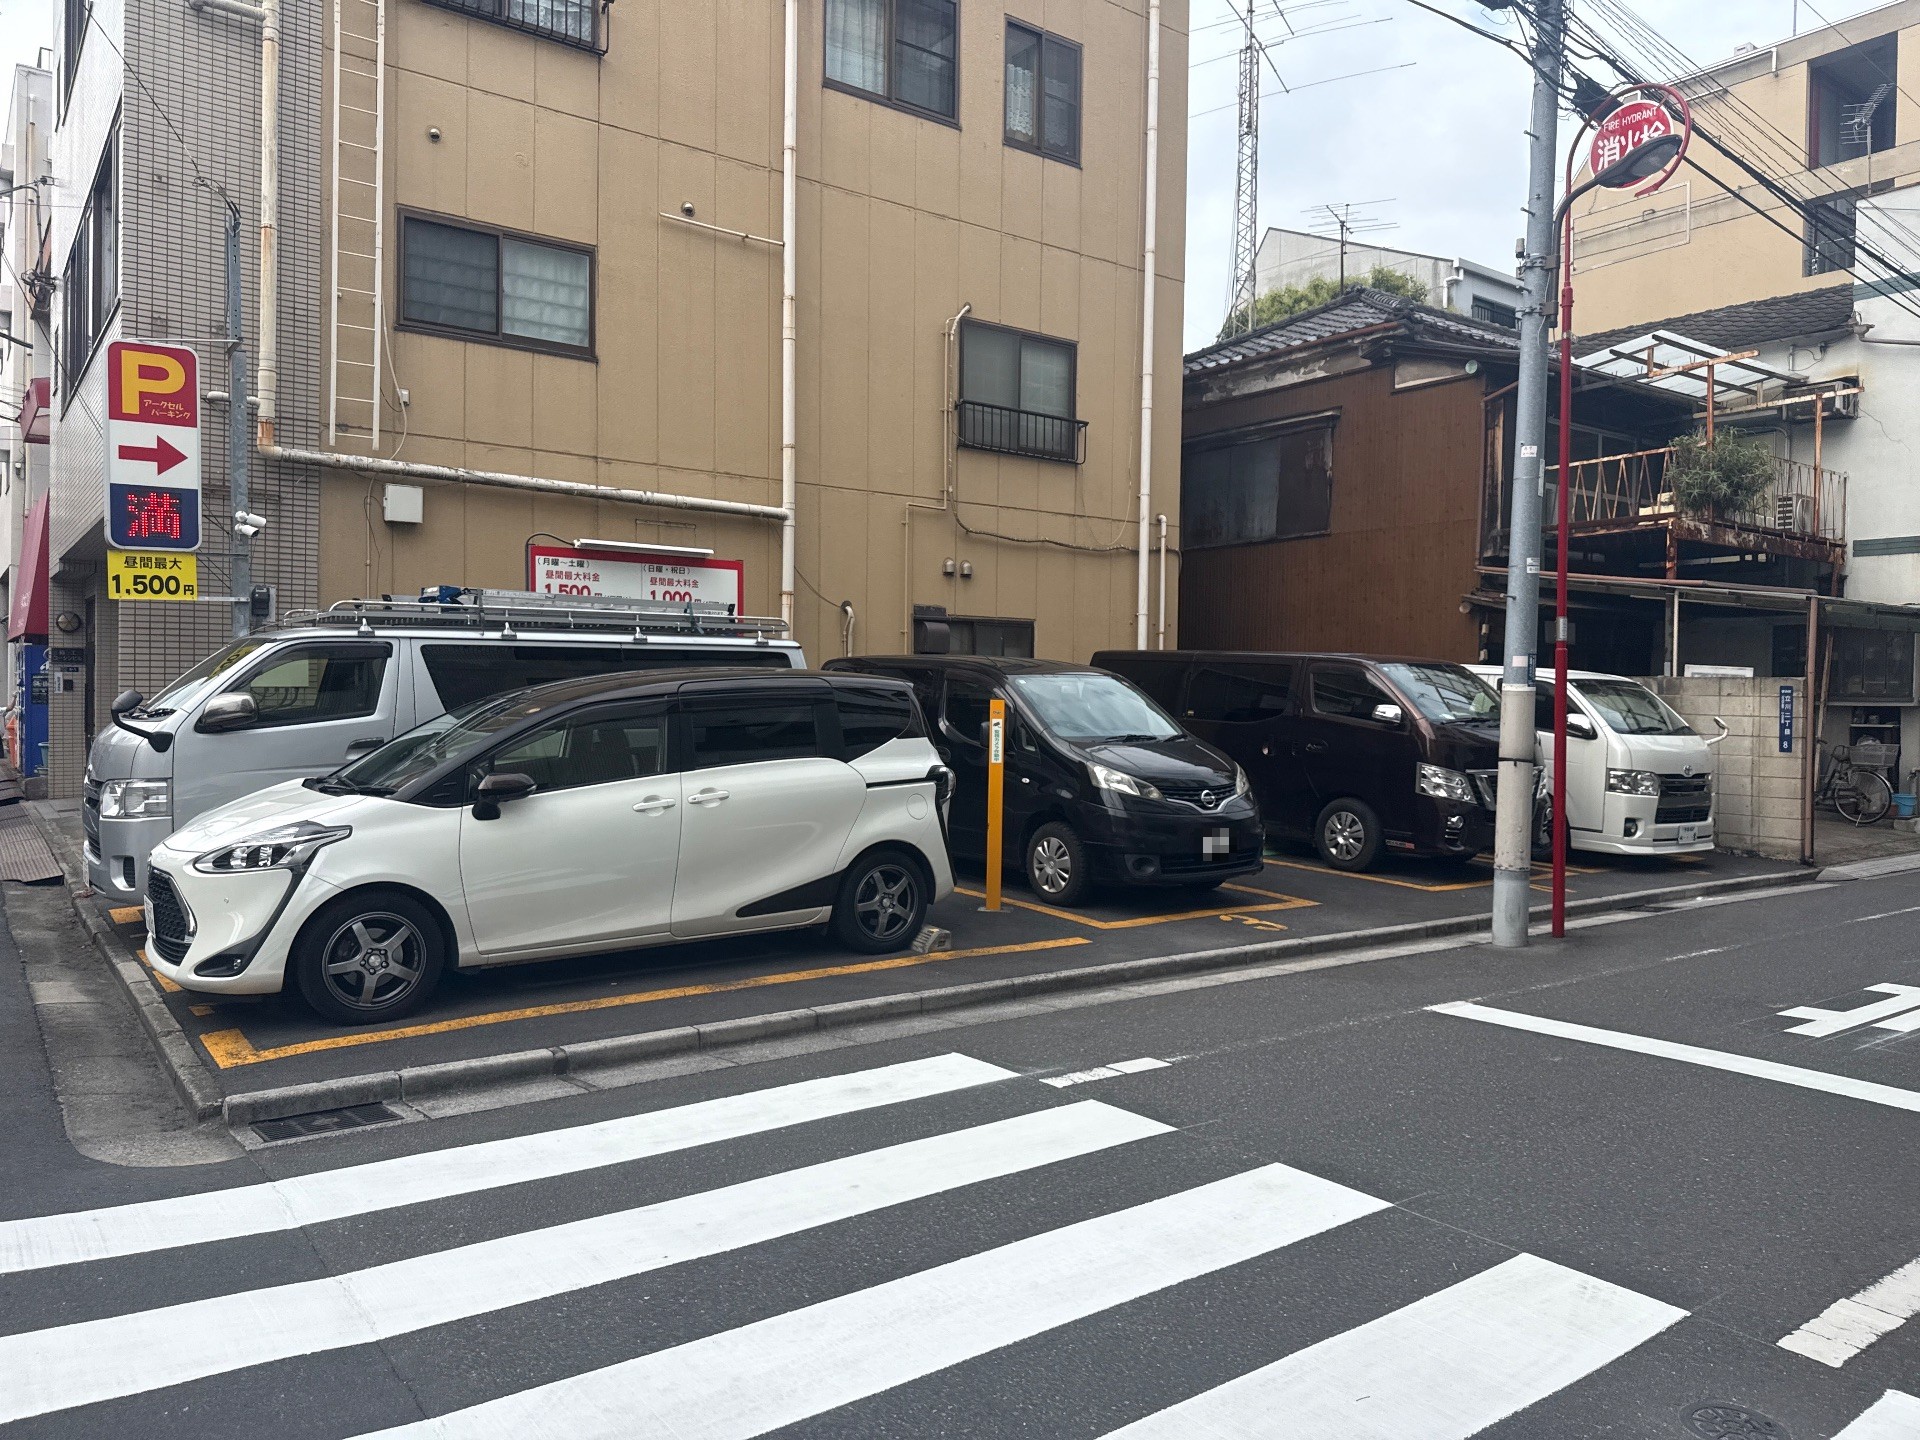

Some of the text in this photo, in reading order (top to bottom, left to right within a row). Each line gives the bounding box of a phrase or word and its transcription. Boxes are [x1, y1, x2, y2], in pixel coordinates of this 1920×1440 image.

[1603, 107, 1658, 132] FIRE HYDRANT
[121, 350, 186, 414] P
[143, 399, 184, 411] アークセル
[127, 492, 180, 539] 満
[124, 555, 182, 570] 昼間最大
[111, 574, 194, 596] 1,500円
[545, 570, 600, 582] 昼間最大料金
[649, 576, 699, 588] 昼間最大料金
